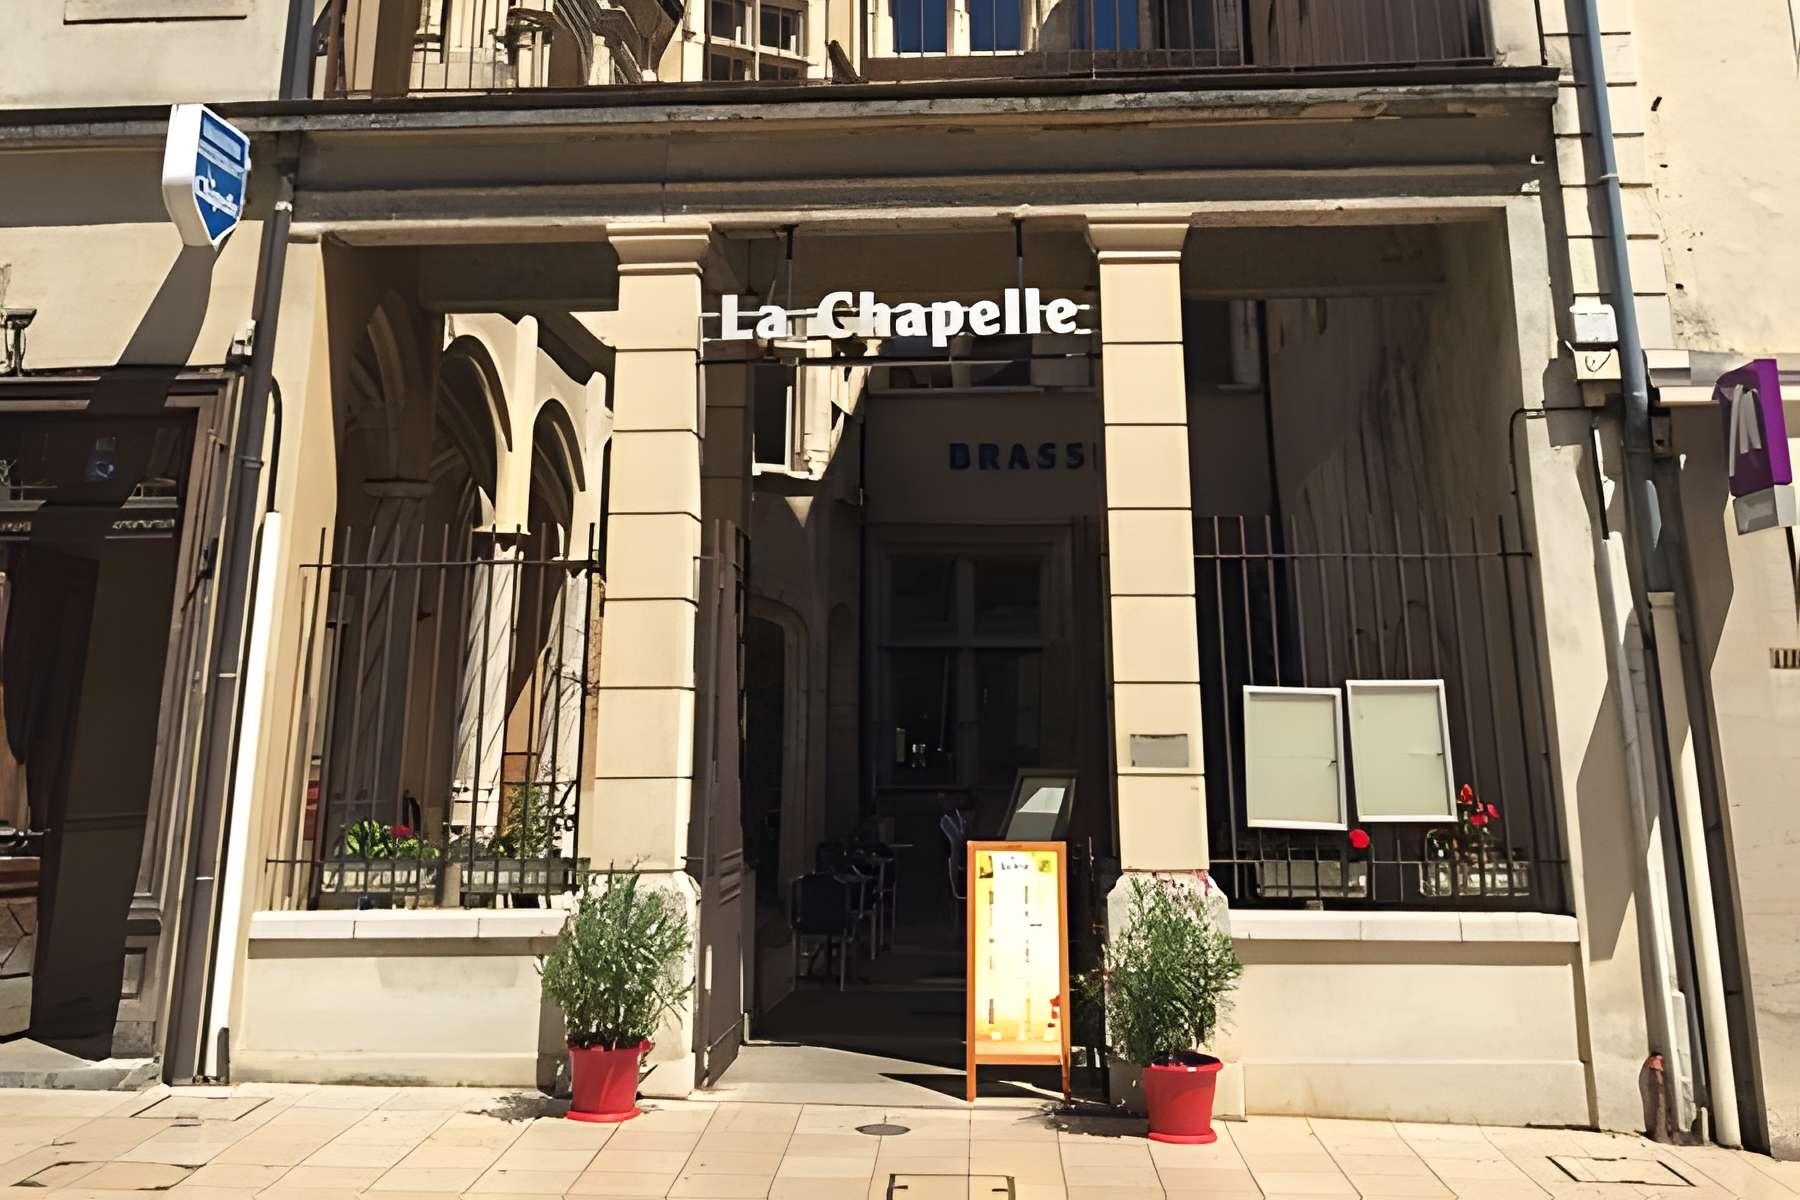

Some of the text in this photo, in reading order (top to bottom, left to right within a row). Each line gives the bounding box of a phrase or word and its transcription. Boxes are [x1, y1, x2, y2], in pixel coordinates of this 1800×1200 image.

[721, 288, 1078, 347] La Chapelle
[949, 442, 1098, 471] BRASS
